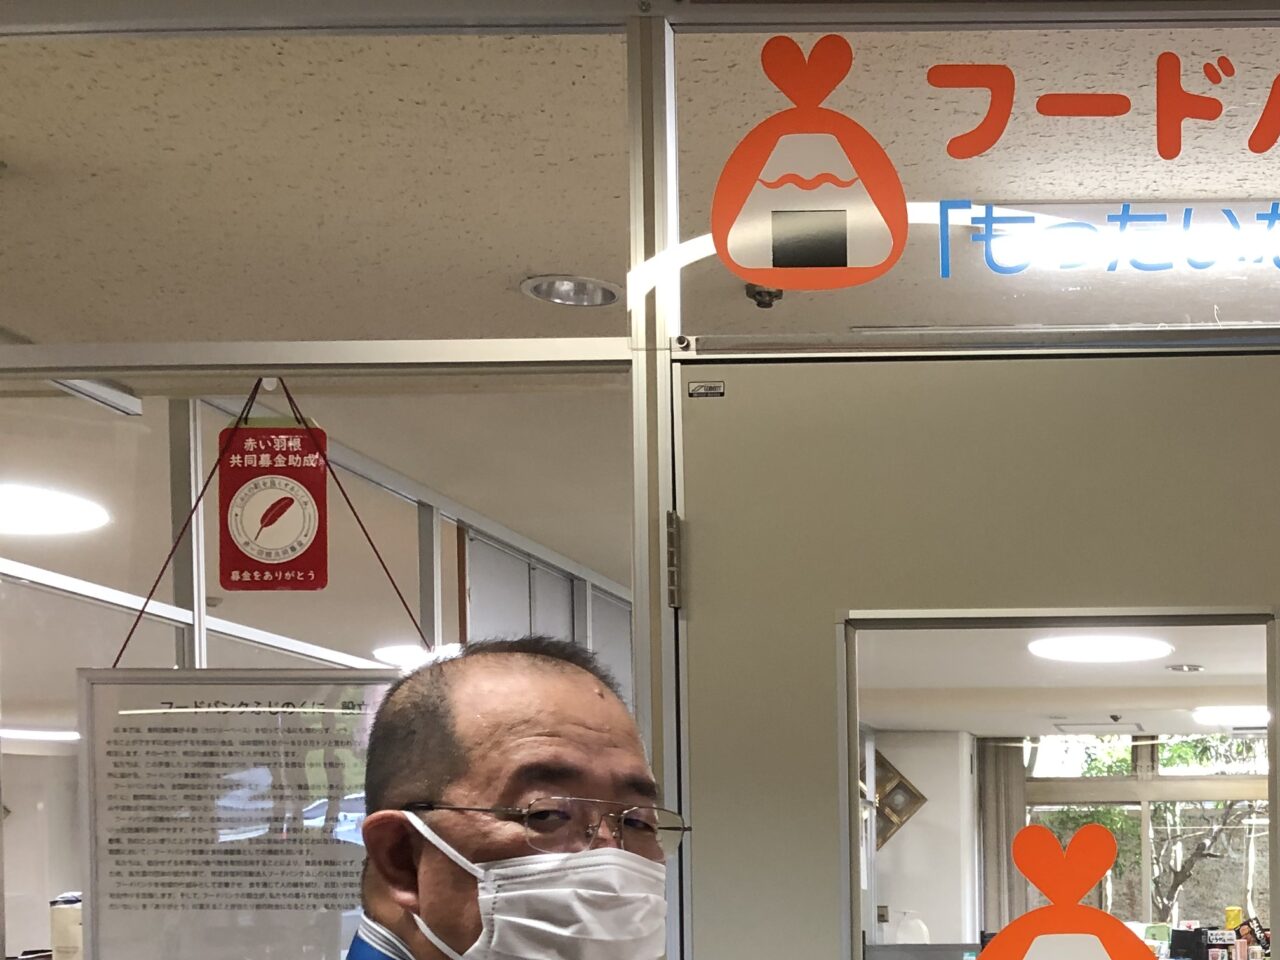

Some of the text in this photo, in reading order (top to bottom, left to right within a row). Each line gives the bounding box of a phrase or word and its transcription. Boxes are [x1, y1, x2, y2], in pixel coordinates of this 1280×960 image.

[244, 437, 302, 452] 赤い羽根
[229, 453, 319, 468] 共同募金助成
[230, 570, 316, 582] 募金をありがとう
